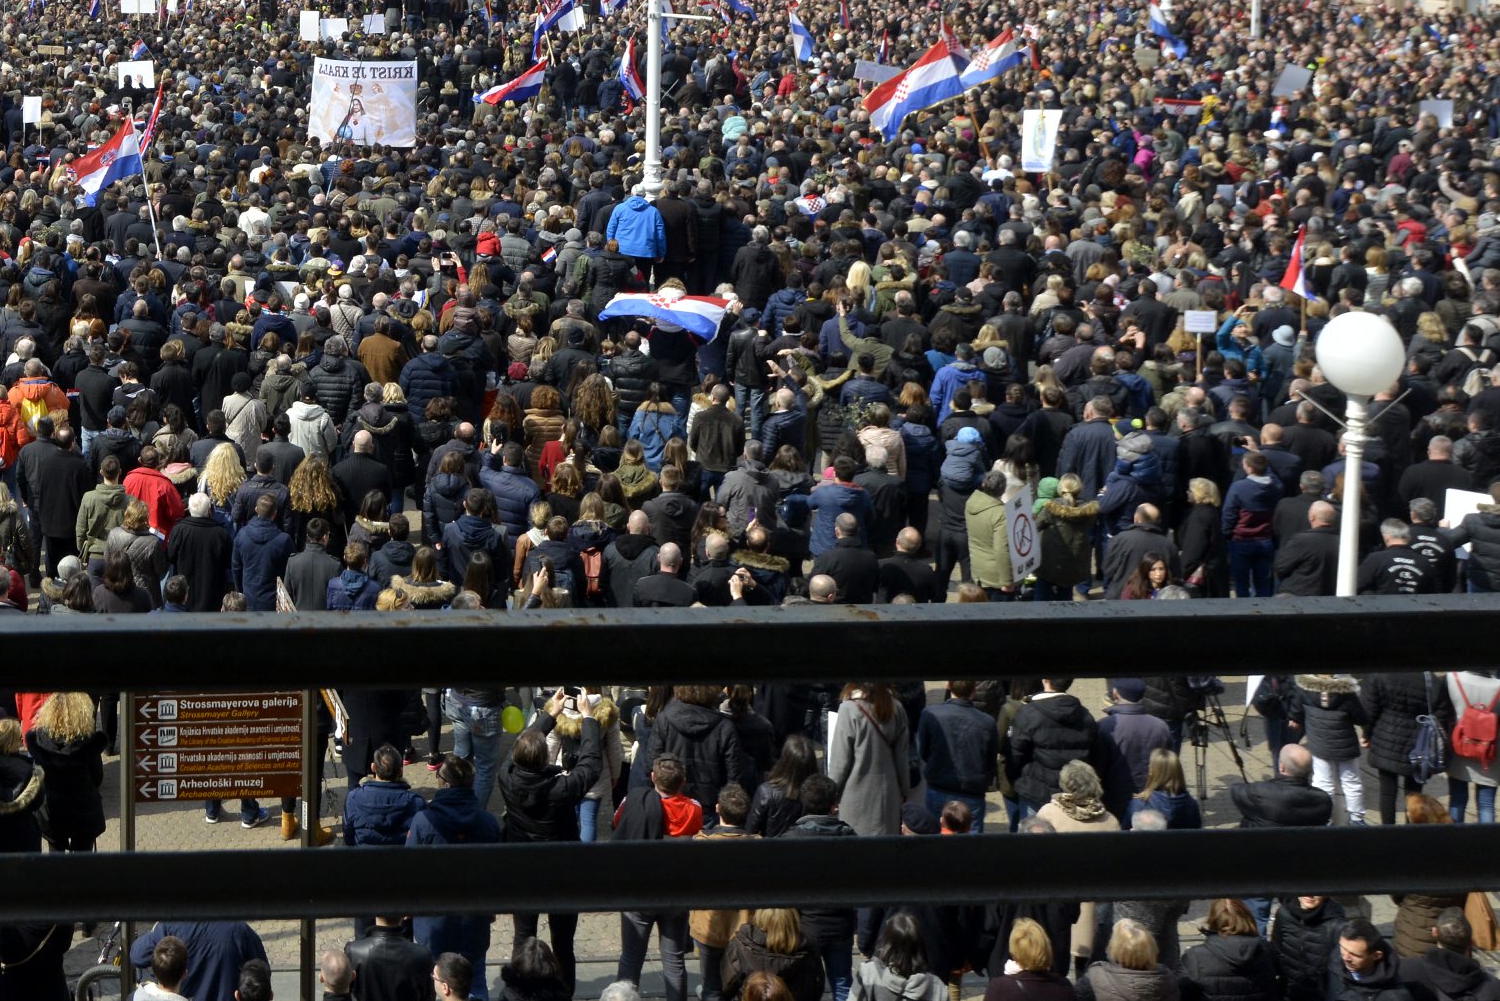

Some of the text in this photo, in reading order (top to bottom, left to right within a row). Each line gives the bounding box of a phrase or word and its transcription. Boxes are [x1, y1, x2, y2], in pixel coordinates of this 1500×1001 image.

[180, 696, 298, 710] Strossmayerova galerija
[180, 709, 259, 719] Strossmayer Gallery
[202, 726, 224, 736] Hrvatske
[224, 725, 249, 736] akademije
[250, 725, 270, 734] znanosti
[273, 724, 299, 734] umjetnosti
[180, 753, 206, 762] Hrvatska
[207, 752, 237, 763] akademija
[238, 751, 263, 761] znanosti
[268, 750, 299, 761] umjetnosti
[180, 764, 205, 772] Croatian
[207, 763, 235, 772] Academy
[236, 762, 243, 770] of
[180, 777, 264, 789] Arheološki muzej
[179, 788, 274, 799] Archaeological Museum
